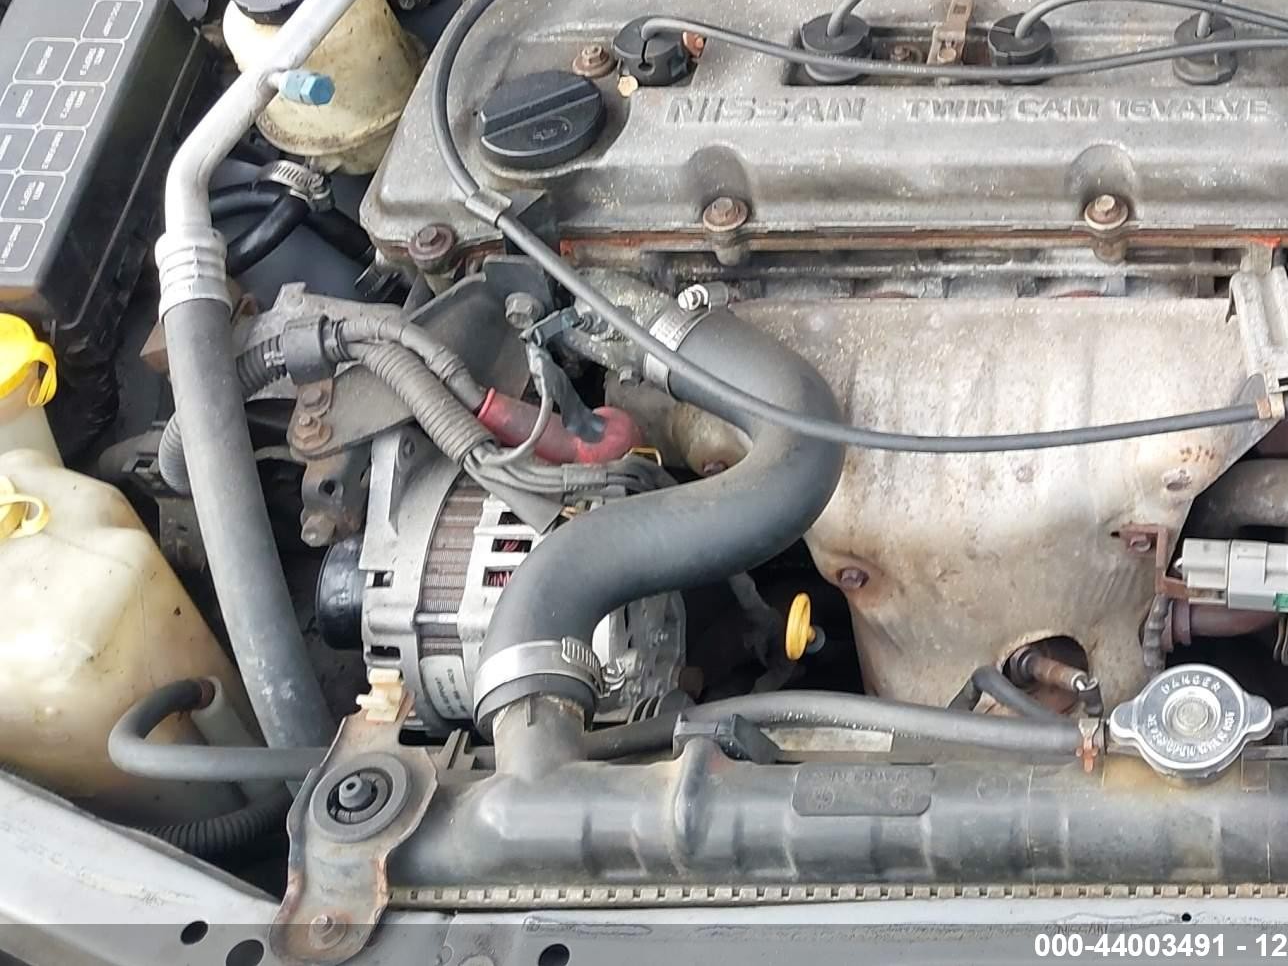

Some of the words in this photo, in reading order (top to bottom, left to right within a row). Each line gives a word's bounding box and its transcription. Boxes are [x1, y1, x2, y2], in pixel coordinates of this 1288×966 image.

[665, 96, 866, 125] NISSAN
[904, 97, 1004, 123] TWIN
[1015, 97, 1100, 123] CAM
[1161, 674, 1220, 694] DANGER
